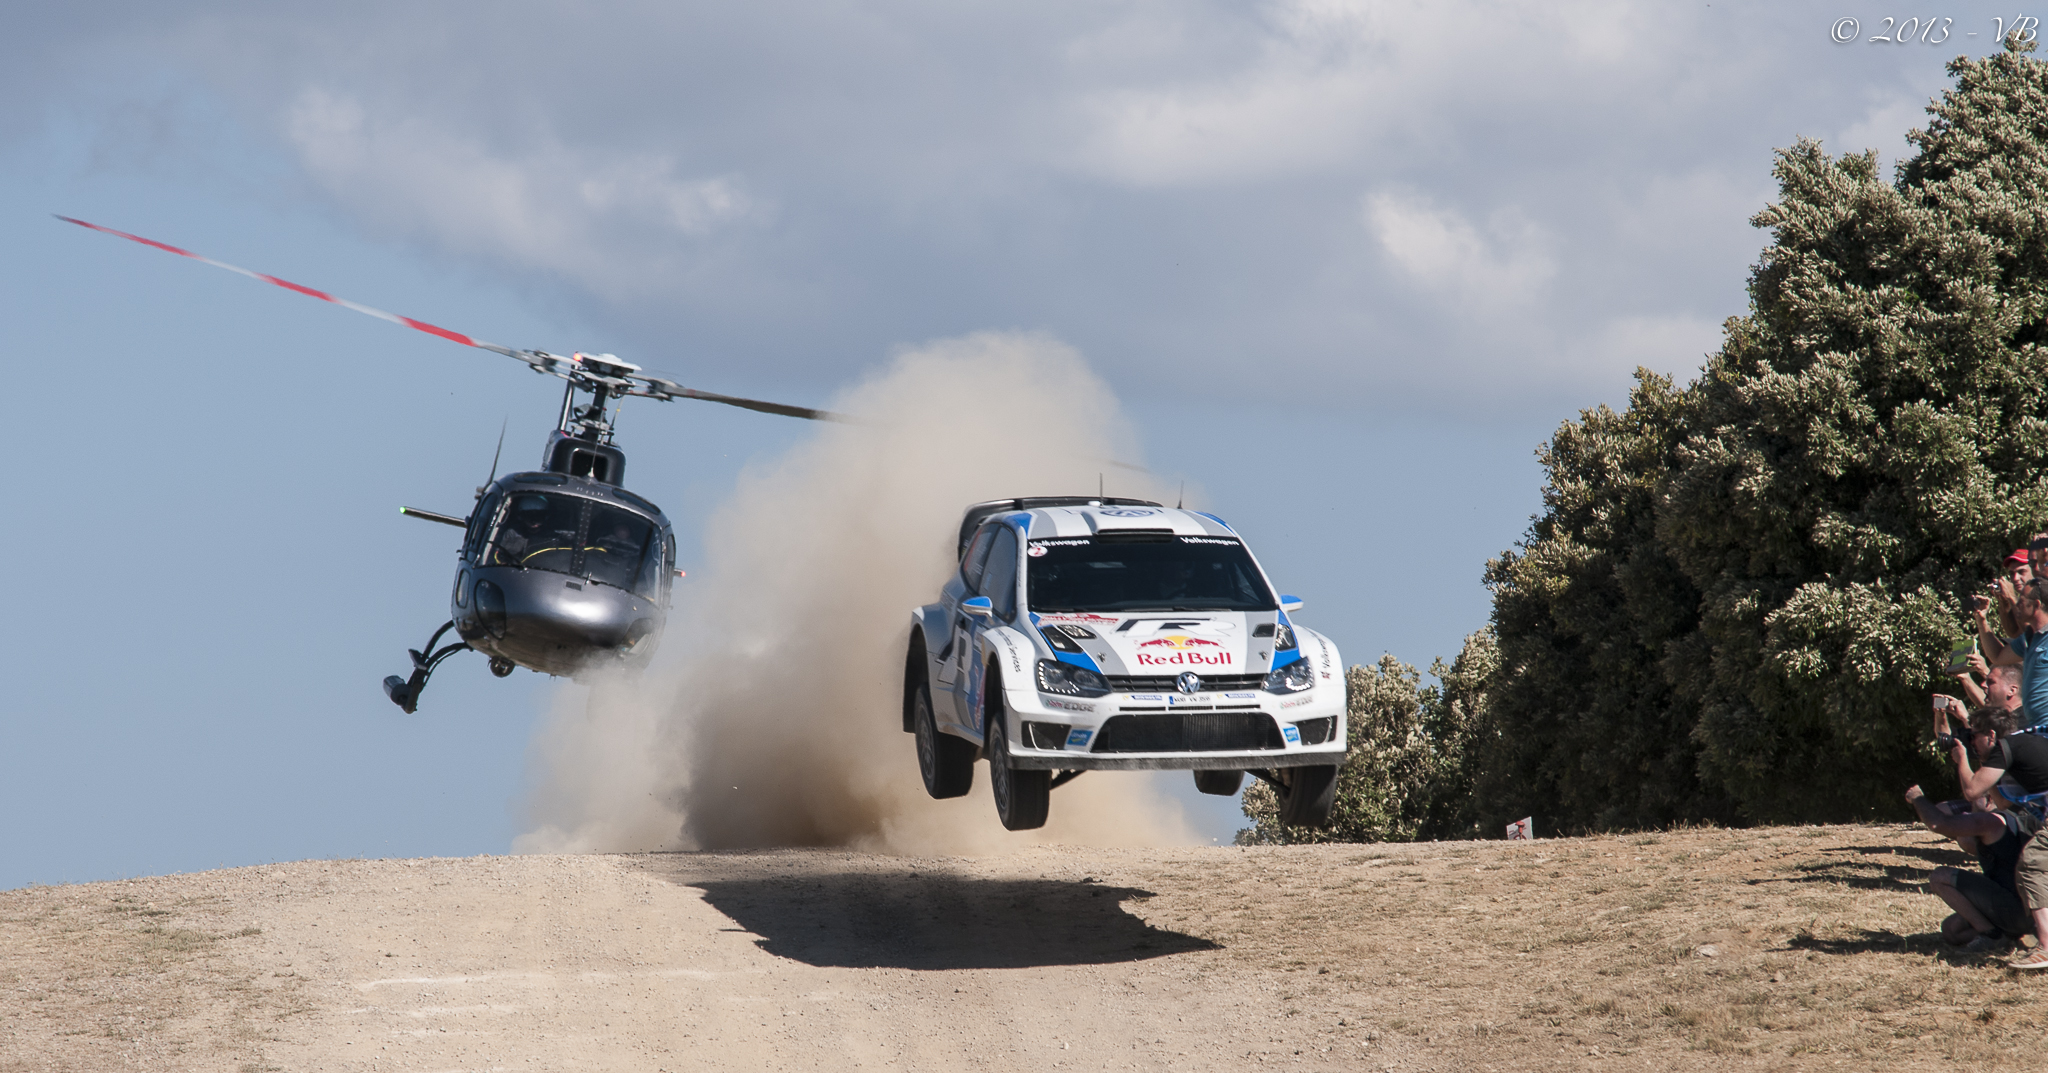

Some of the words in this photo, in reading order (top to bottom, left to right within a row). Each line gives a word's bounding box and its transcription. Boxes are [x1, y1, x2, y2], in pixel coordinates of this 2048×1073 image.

[1180, 536, 1240, 546] Volkswagen
[1136, 651, 1185, 666] Red
[1187, 651, 1232, 665] Bull
